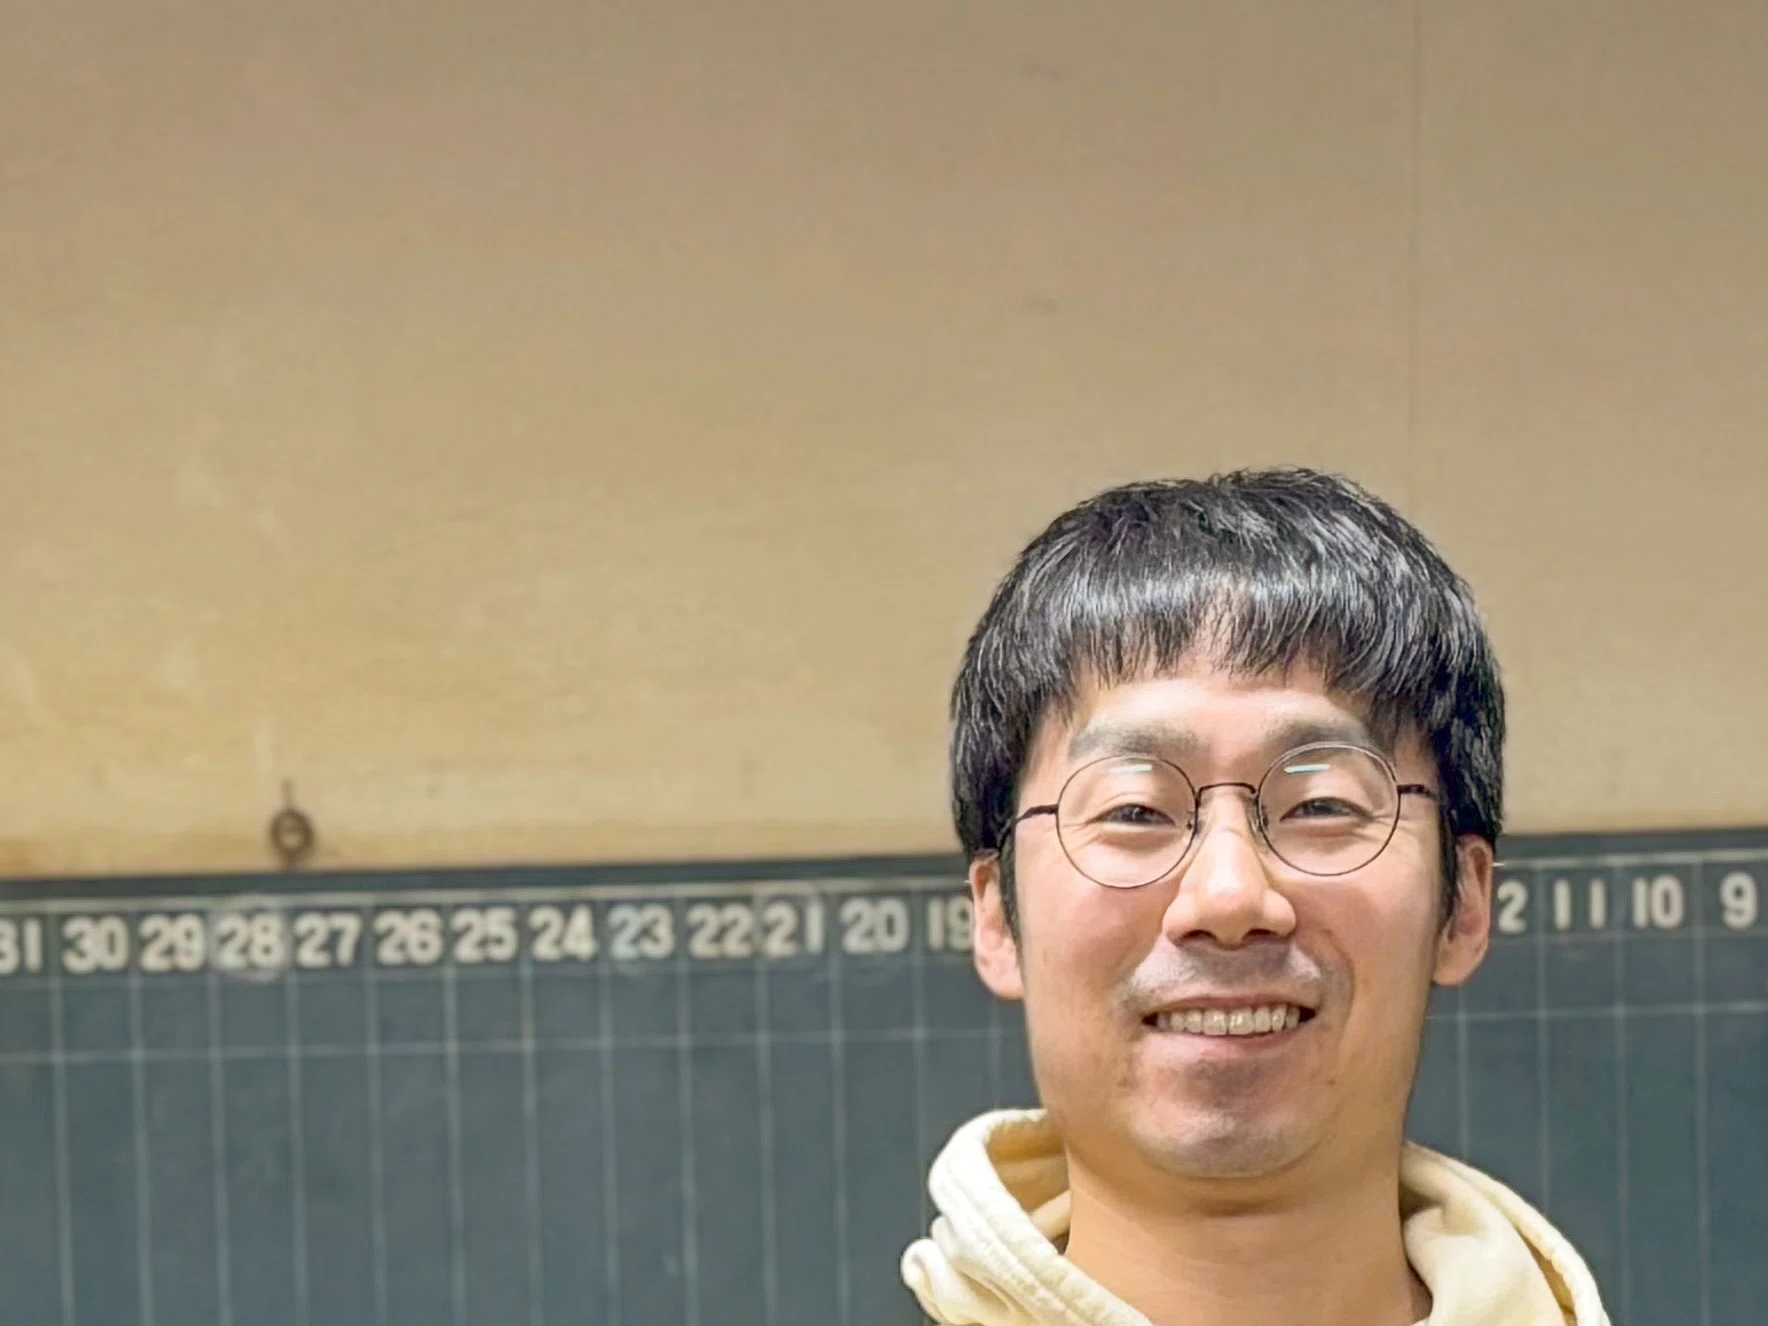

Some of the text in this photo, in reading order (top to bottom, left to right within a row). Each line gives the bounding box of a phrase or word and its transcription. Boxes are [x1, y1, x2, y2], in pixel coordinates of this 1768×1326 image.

[63, 915, 129, 973] 30
[139, 914, 207, 971] 29
[216, 913, 284, 969] 28
[293, 912, 362, 967] 27
[374, 909, 444, 964] 26
[451, 907, 519, 962] 25
[529, 906, 598, 961] 24
[609, 904, 675, 960] 23
[687, 903, 754, 959] 22
[762, 901, 824, 958] 21
[839, 898, 909, 953] 20
[928, 895, 974, 950] 19
[1496, 879, 1528, 934] 2
[1553, 879, 1606, 930] 11
[1632, 874, 1684, 929] 10
[1720, 871, 1758, 930] 9
